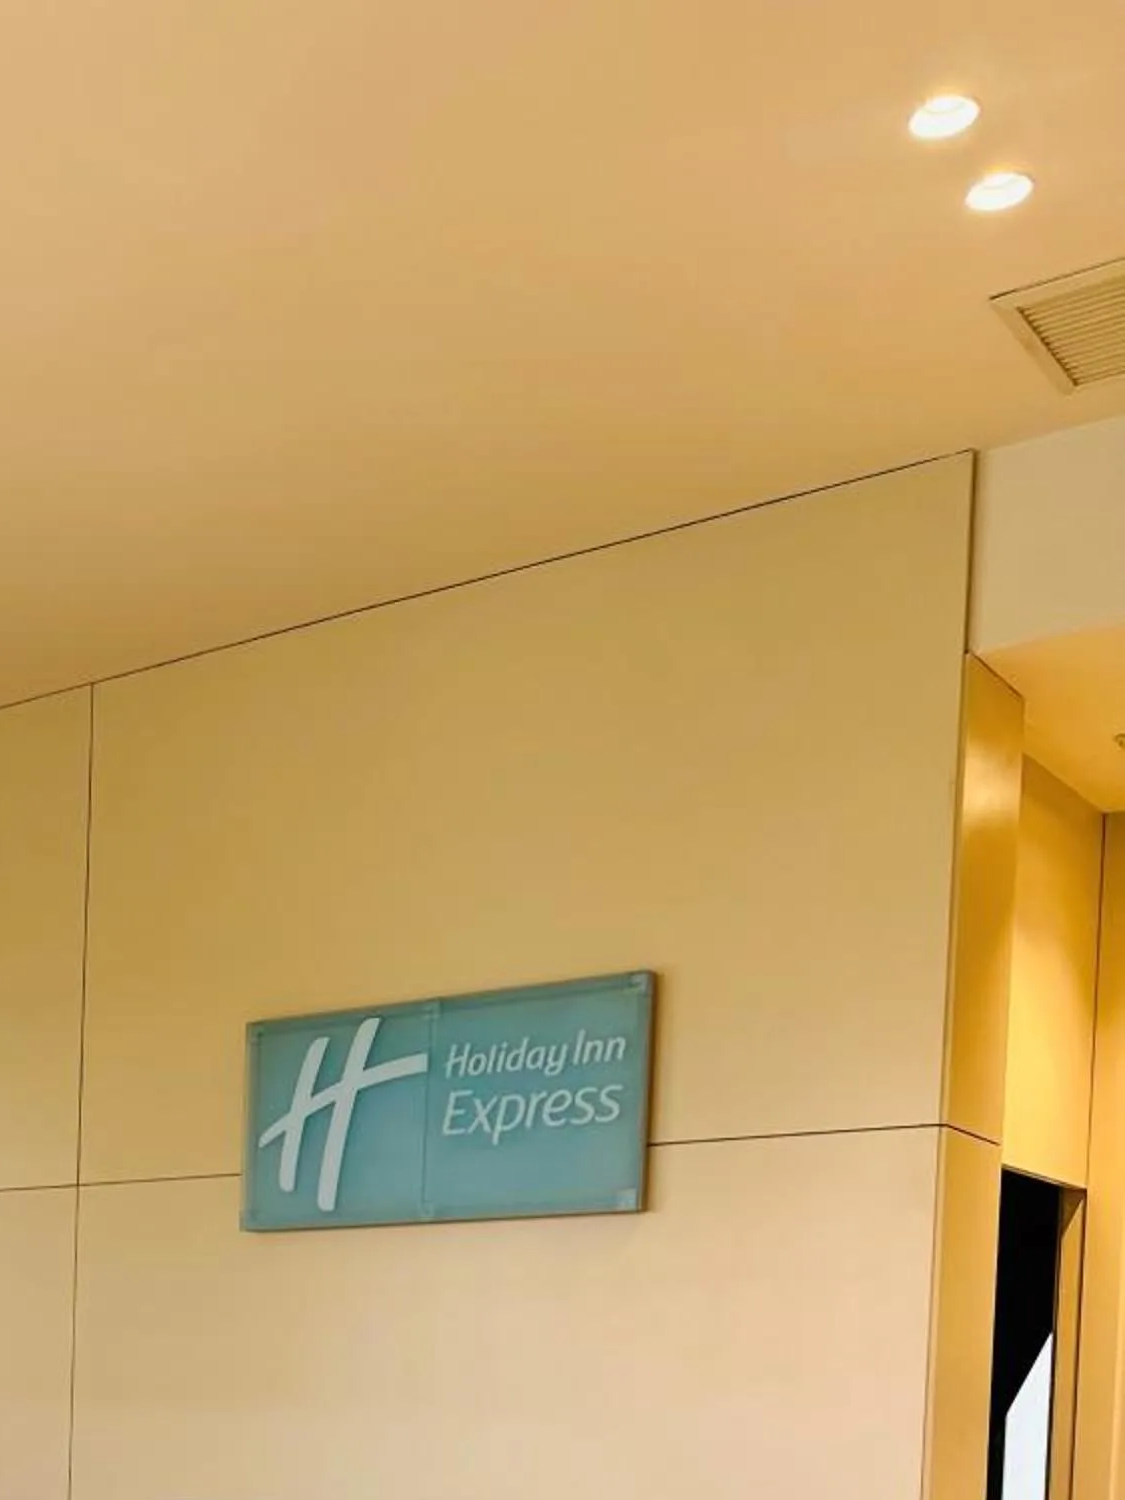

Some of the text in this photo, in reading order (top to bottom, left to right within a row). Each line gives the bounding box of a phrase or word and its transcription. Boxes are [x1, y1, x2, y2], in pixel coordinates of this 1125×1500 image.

[446, 1029, 626, 1079] Holiday Inn
[443, 1084, 624, 1146] Express
